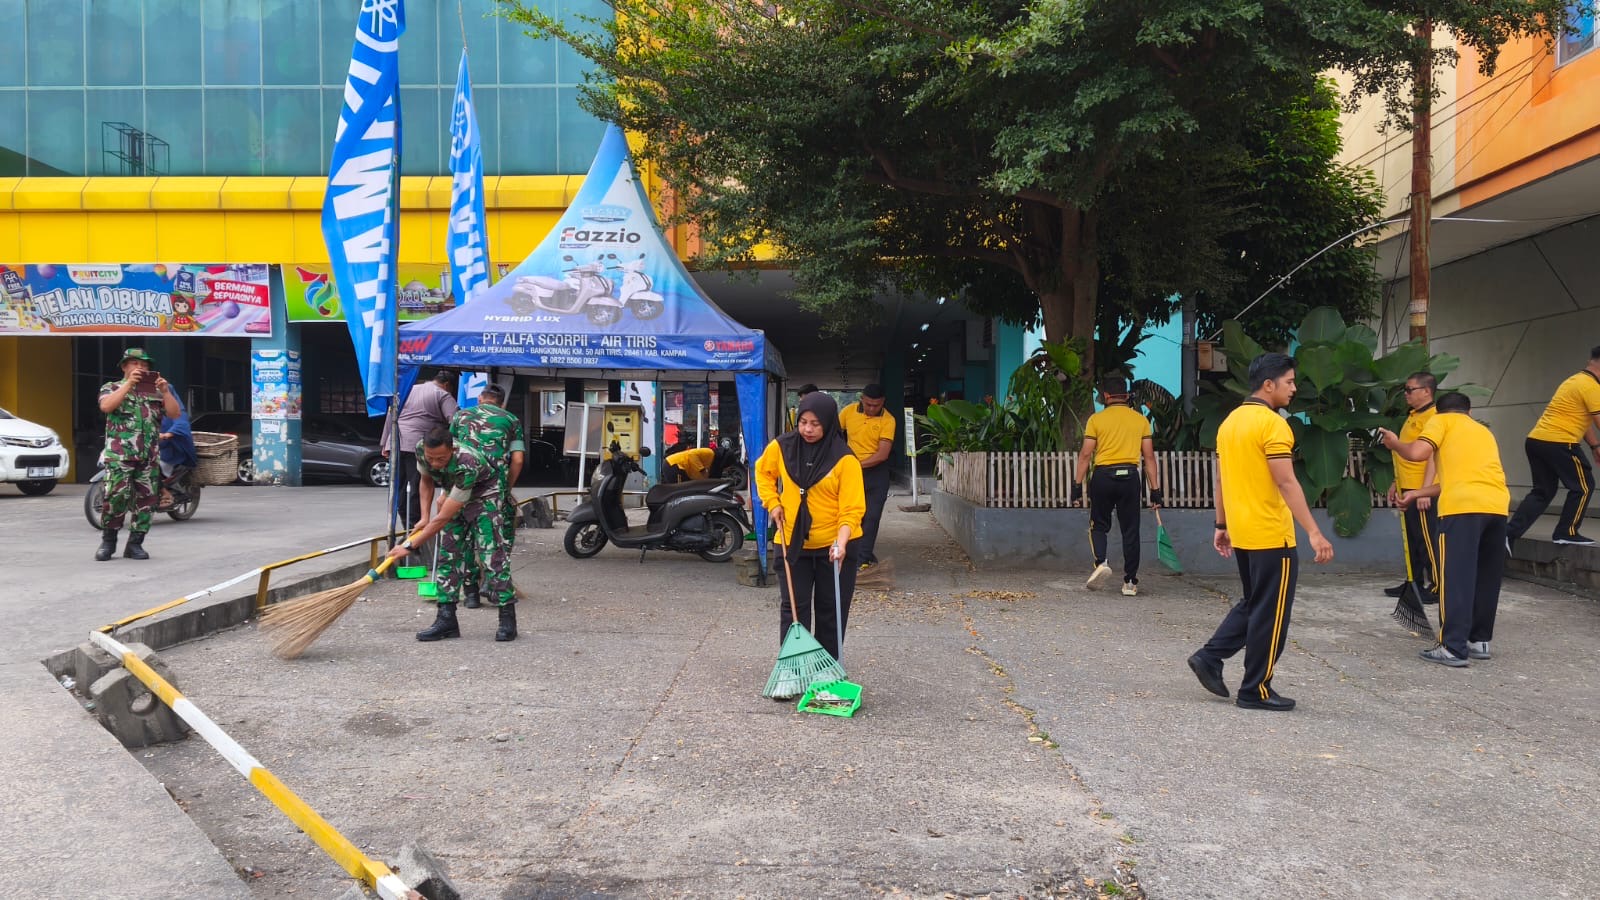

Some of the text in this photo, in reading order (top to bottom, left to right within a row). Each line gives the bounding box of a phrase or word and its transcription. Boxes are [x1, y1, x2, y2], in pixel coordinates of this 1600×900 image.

[561, 226, 641, 243] Fazzio
[72, 270, 119, 278] FRUITCITY
[214, 281, 256, 294] BERMAIN
[33, 287, 172, 317] TELAH DIBUKA
[213, 291, 262, 304] SEPUASNYA
[51, 312, 159, 328] WAHANA BERMAIN
[535, 315, 561, 323] LUX
[482, 332, 500, 345] PT.
[503, 333, 535, 346] ALFA
[600, 335, 622, 348] AIR
[624, 335, 657, 348] TIRIS
[470, 345, 486, 353] RAYA
